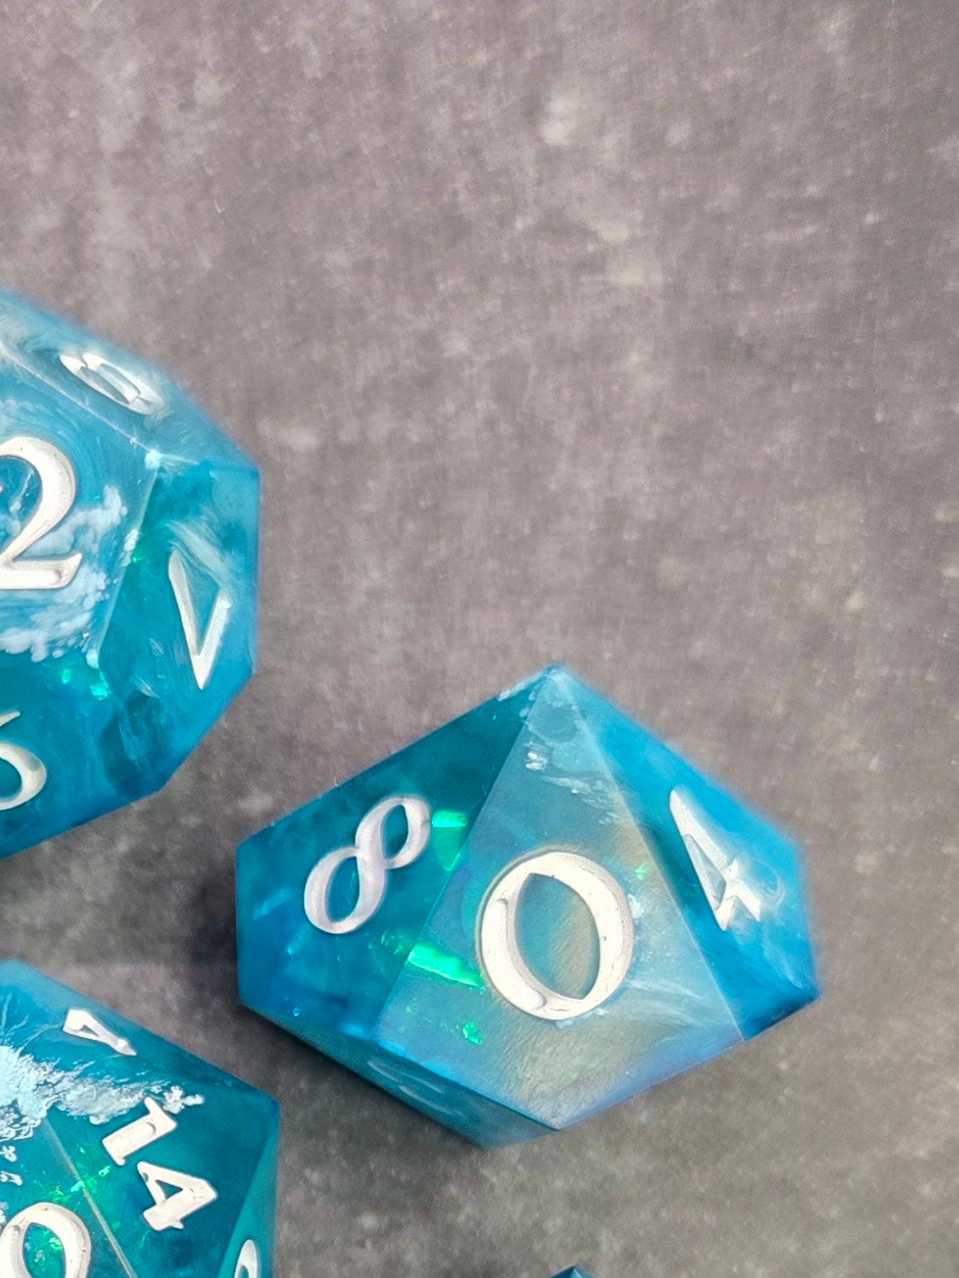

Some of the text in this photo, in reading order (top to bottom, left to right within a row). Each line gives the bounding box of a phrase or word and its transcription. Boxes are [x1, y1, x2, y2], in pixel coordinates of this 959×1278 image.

[304, 796, 431, 934] 8
[670, 788, 761, 931] 4
[481, 852, 634, 1021] 0
[102, 1097, 218, 1231] 14
